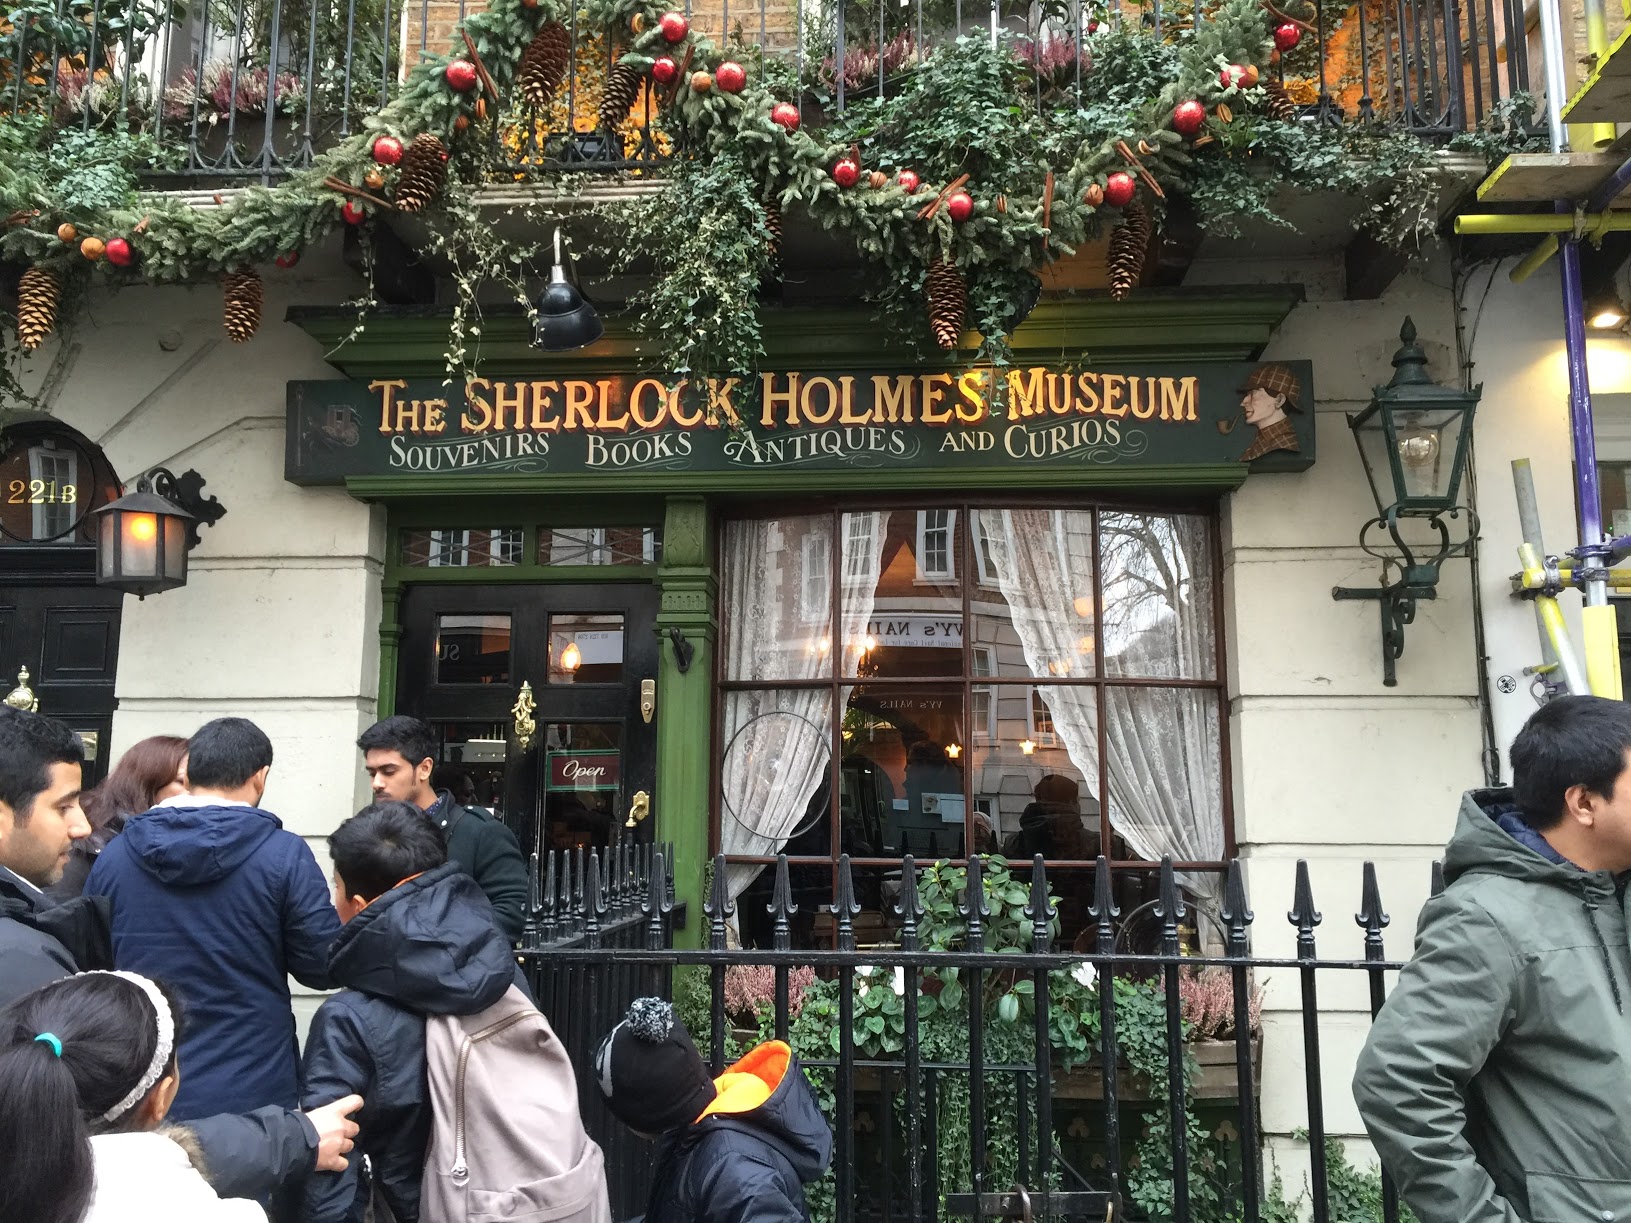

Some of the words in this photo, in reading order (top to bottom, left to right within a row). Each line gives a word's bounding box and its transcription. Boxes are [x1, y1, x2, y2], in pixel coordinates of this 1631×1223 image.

[368, 379, 448, 434] THE
[461, 376, 741, 433] SHERLOCK
[759, 370, 986, 427] HOLMES
[1006, 366, 1200, 422] MUSEUM
[388, 432, 551, 470] SOUVENIRS
[585, 431, 693, 467] BOOKS
[723, 427, 906, 464] ANTIQUES
[939, 430, 995, 453] AND
[1003, 418, 1121, 459] CURIOS
[7, 479, 77, 504] 221B
[562, 759, 607, 781] Open
